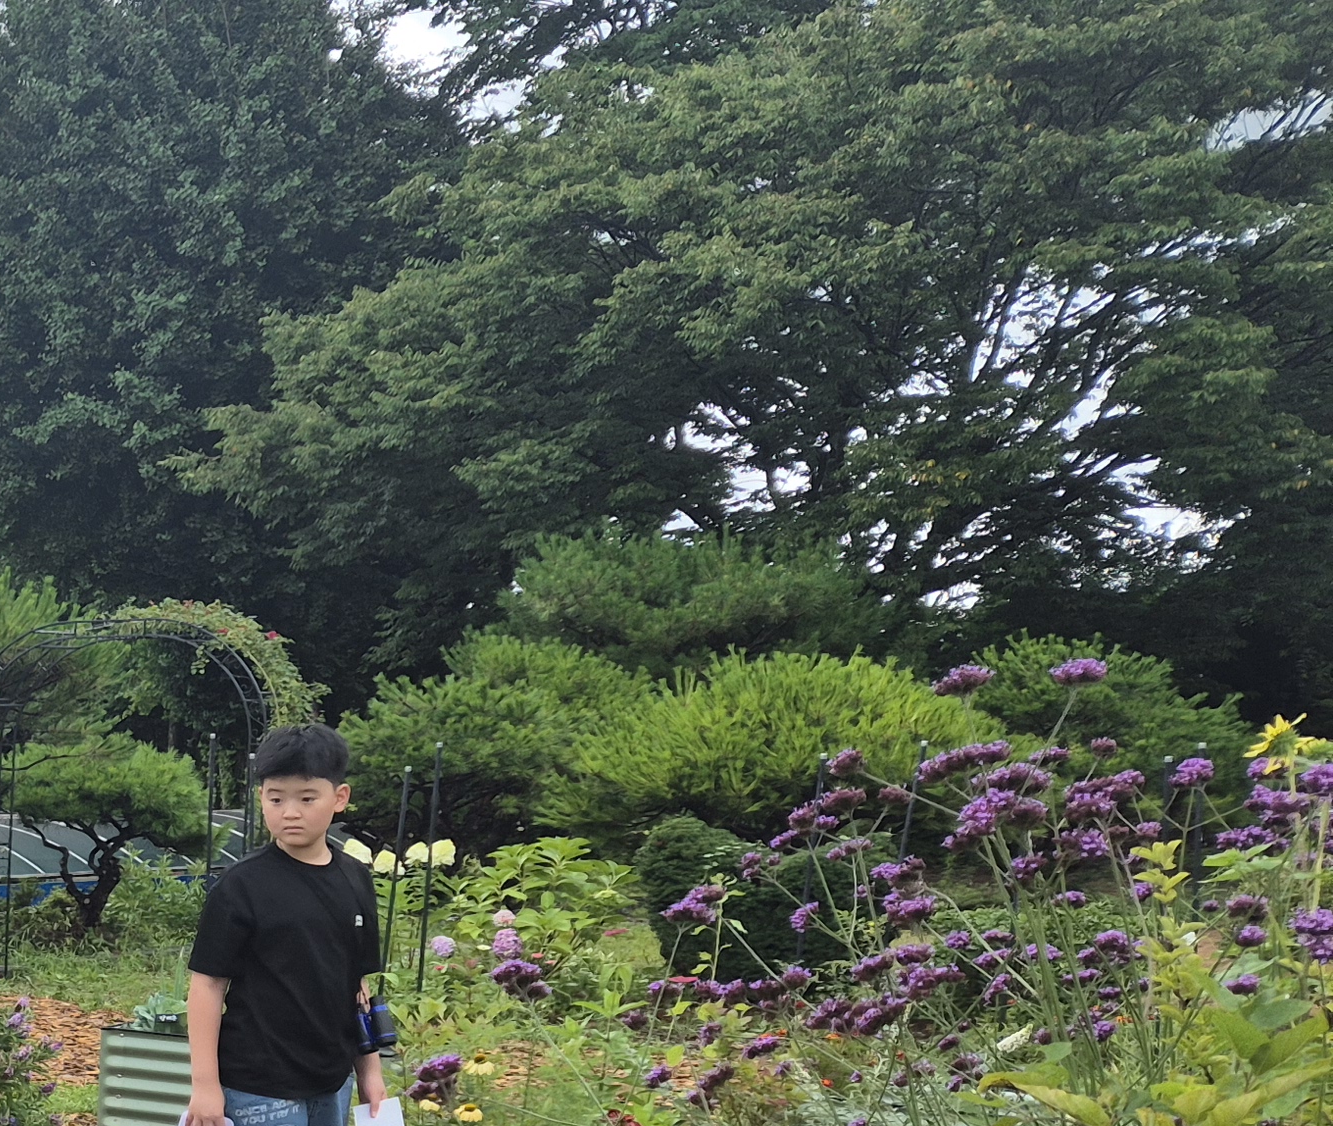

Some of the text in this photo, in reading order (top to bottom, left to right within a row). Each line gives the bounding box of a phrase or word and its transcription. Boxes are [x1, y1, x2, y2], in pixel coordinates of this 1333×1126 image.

[235, 1104, 268, 1117] ONCE
[241, 1104, 300, 1126] YOU TRY IT
